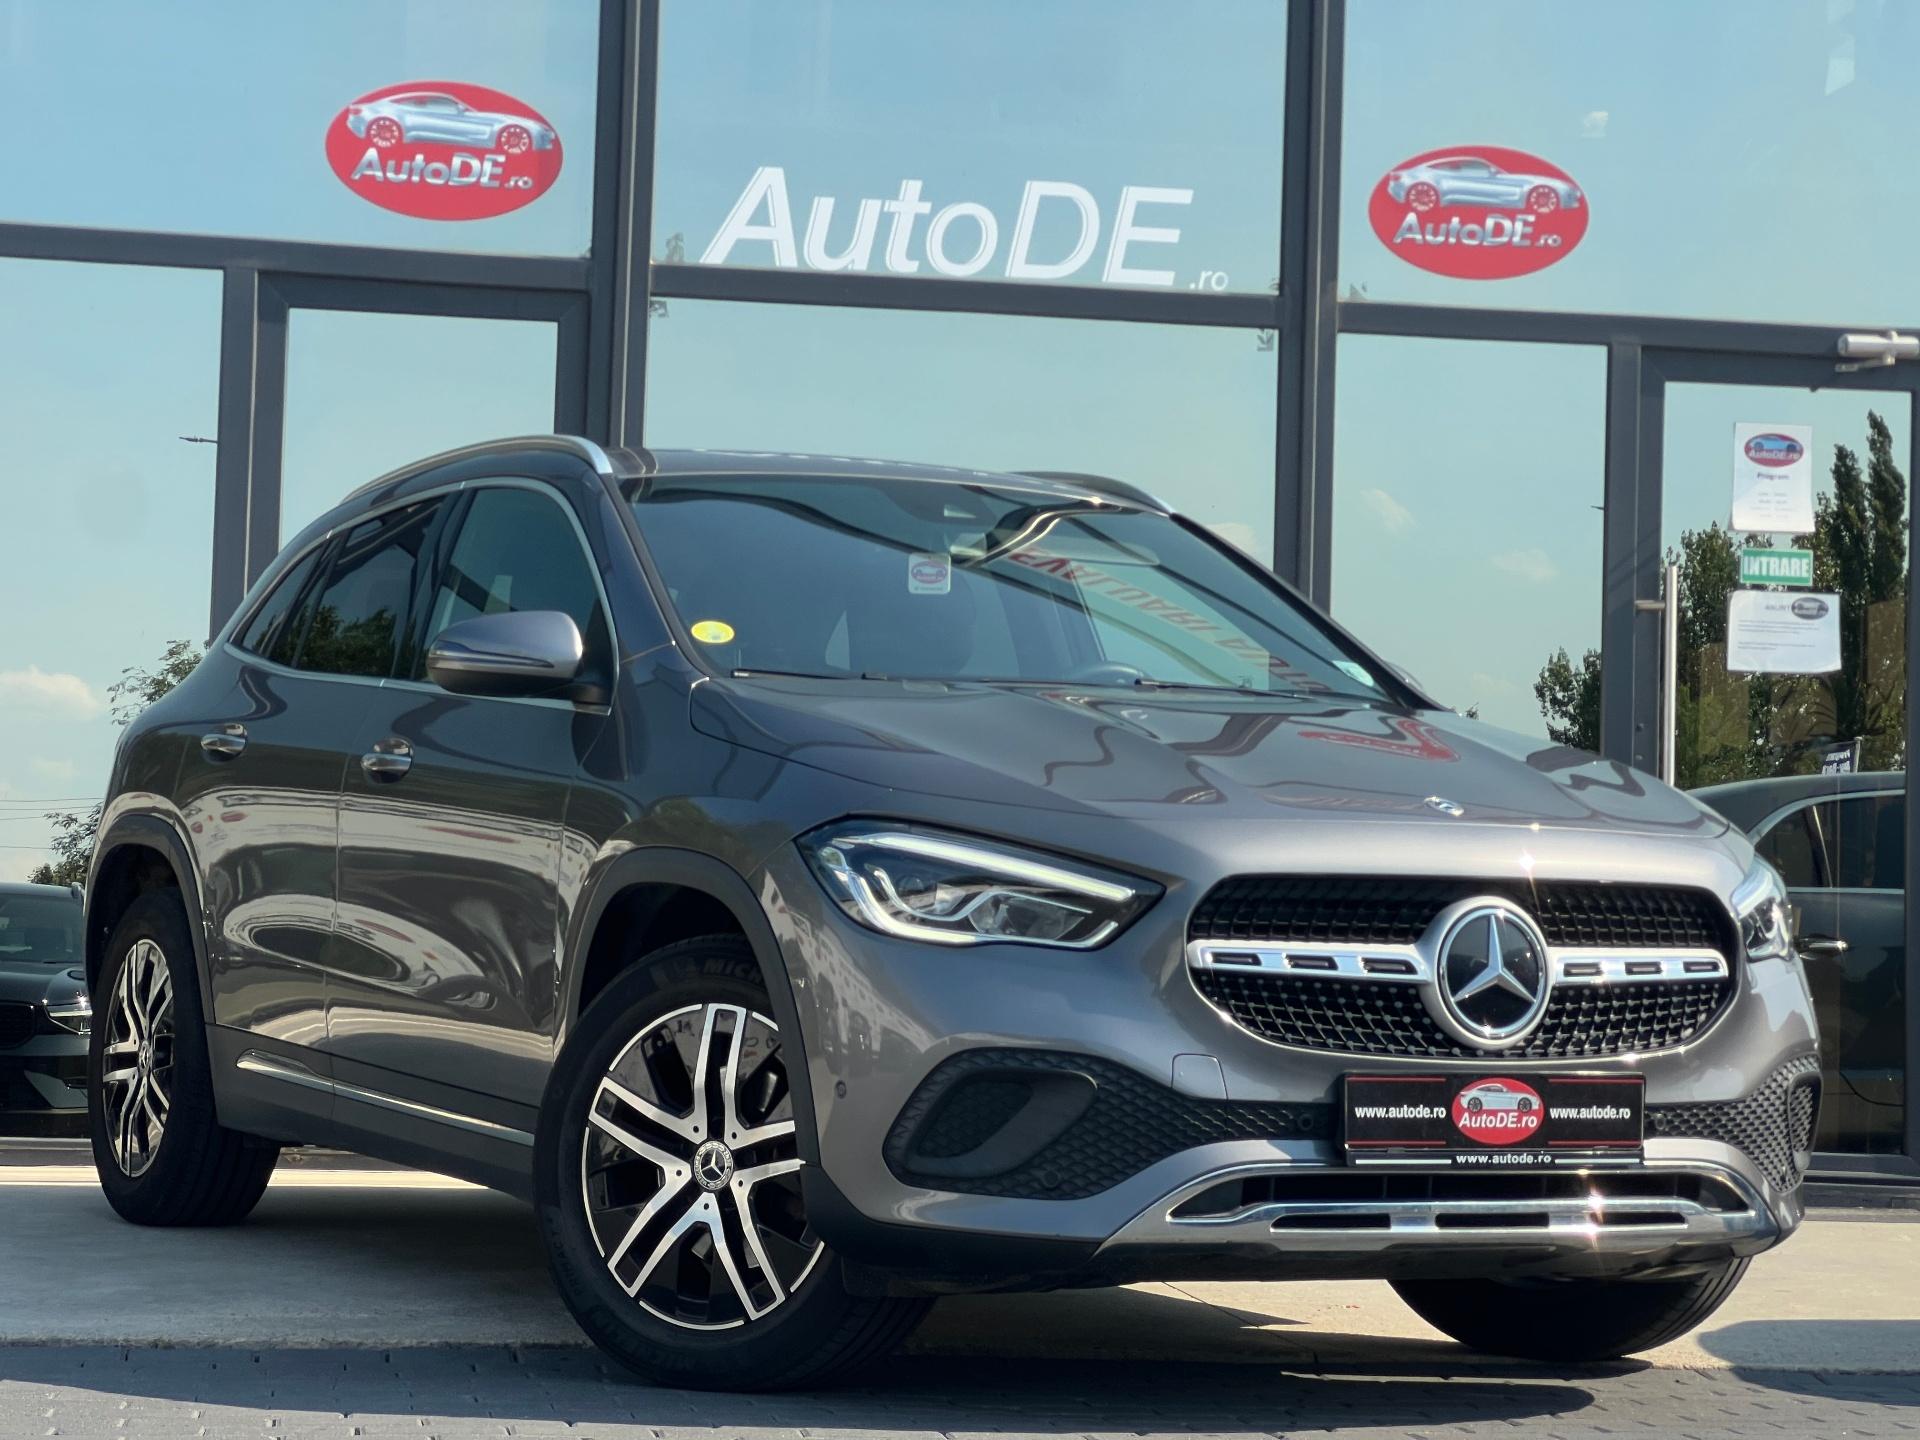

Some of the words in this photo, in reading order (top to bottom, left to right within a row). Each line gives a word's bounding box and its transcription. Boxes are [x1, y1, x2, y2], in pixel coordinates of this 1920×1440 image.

[1743, 555, 1810, 577] INTRARE
[1354, 1105, 1446, 1119] www.autode.ro
[1550, 1108, 1631, 1120] www.autode.ro
[1459, 1112, 1538, 1128] AutoDE.ro
[1456, 1153, 1552, 1165] www.autode.ro
